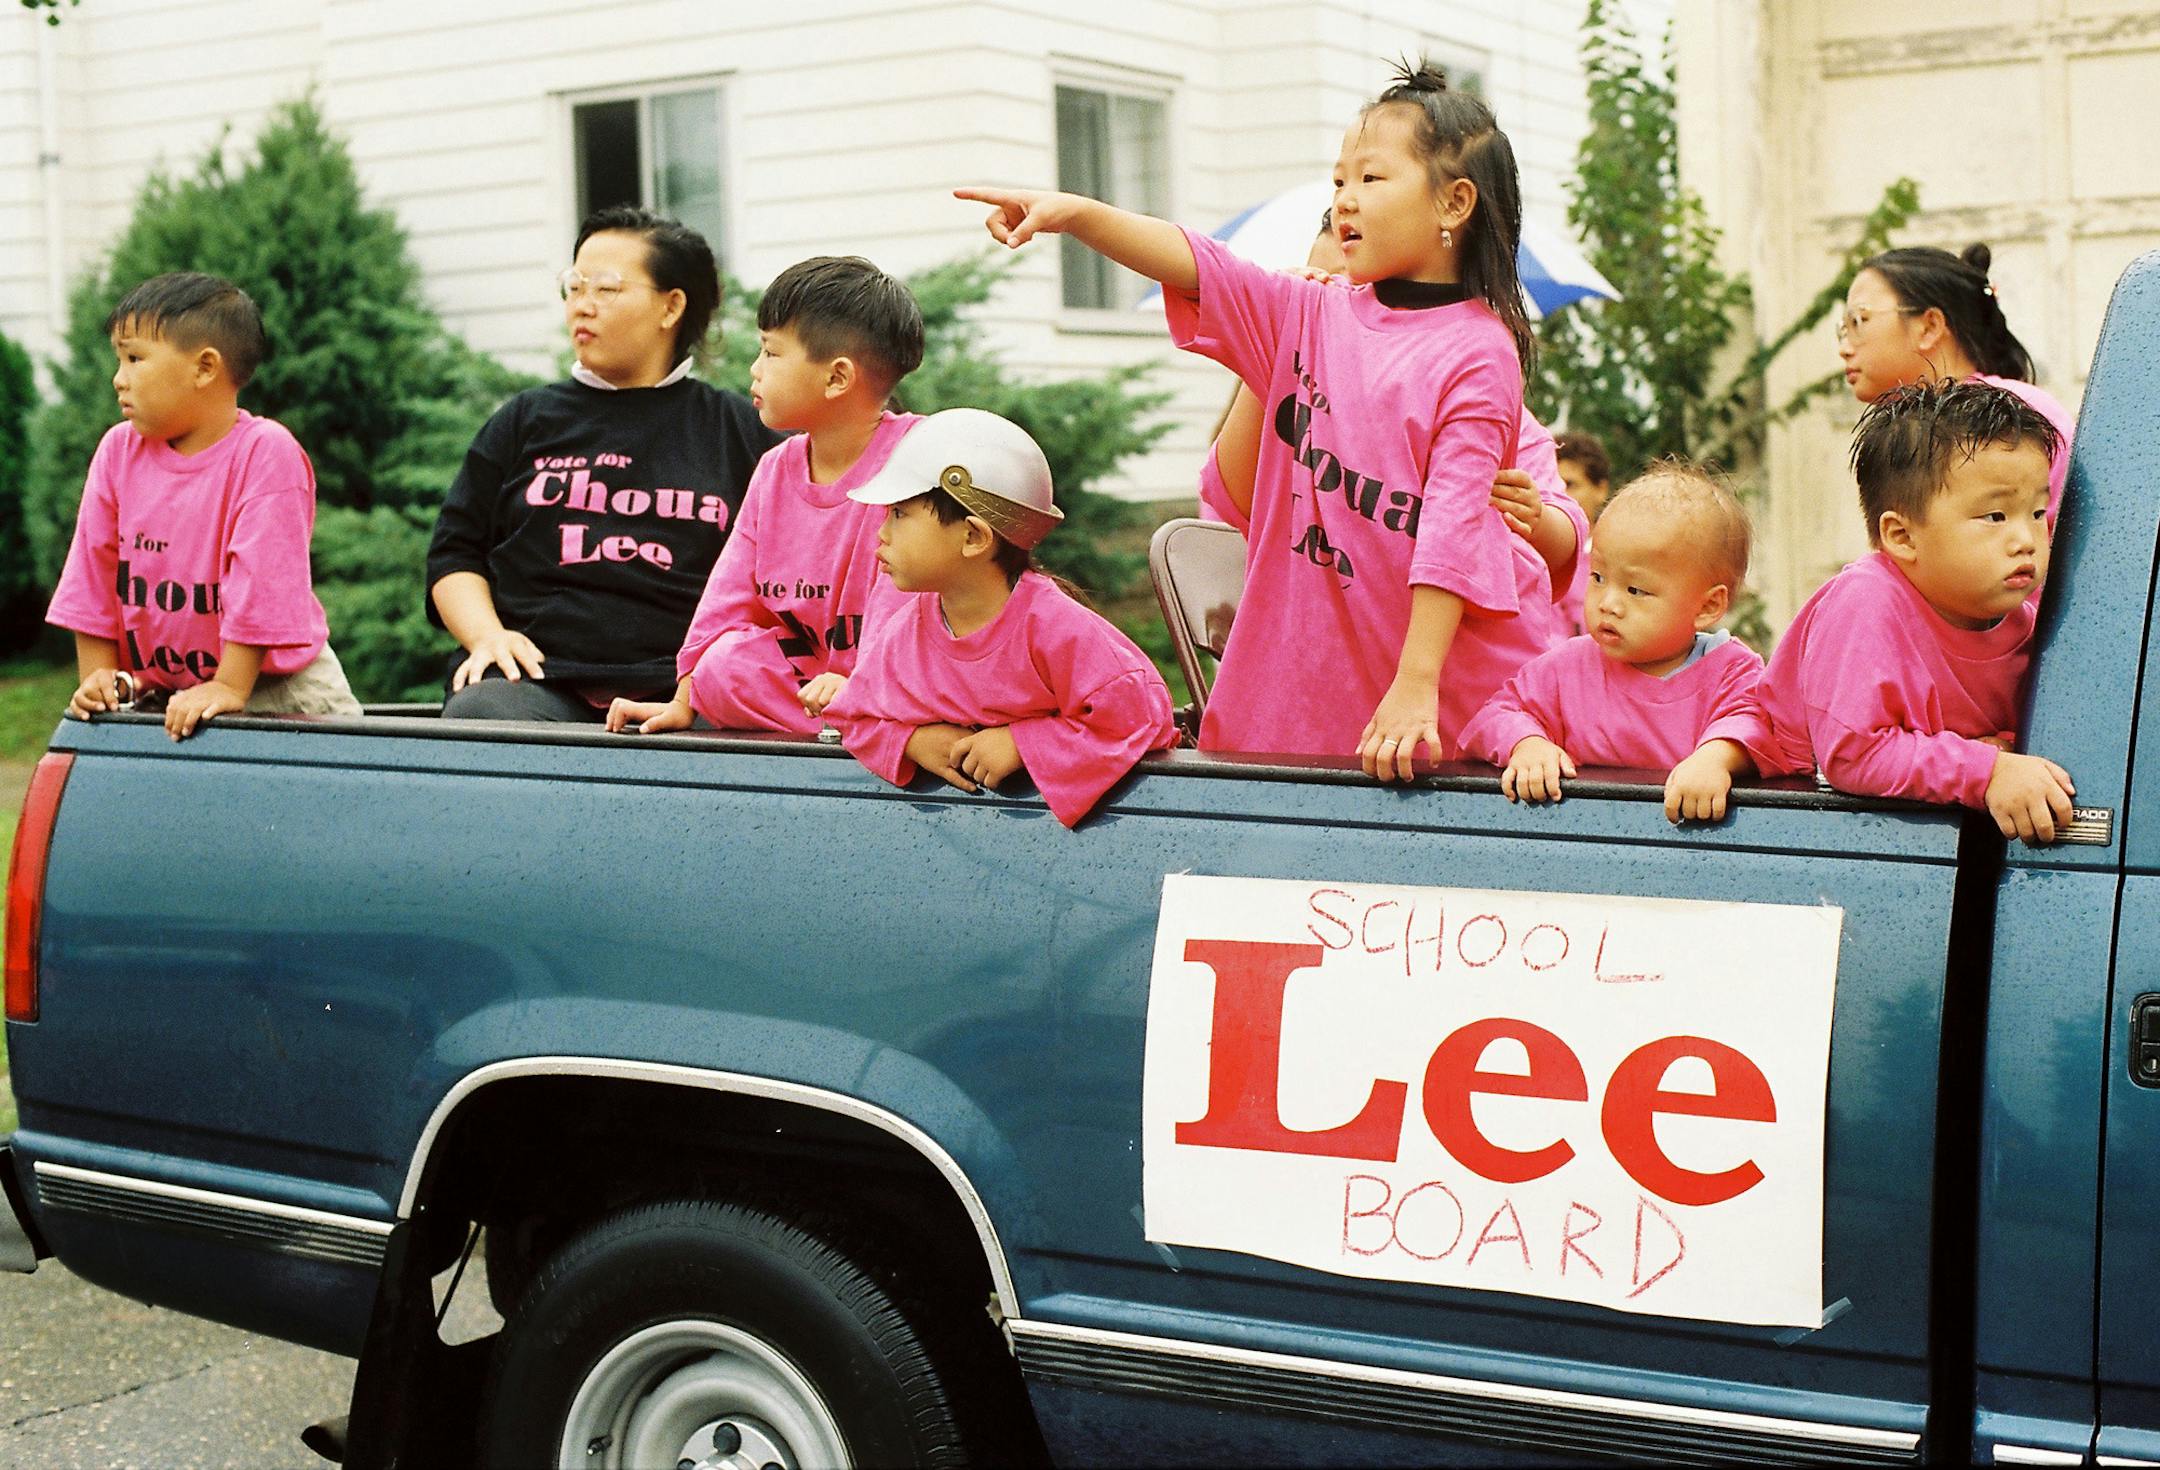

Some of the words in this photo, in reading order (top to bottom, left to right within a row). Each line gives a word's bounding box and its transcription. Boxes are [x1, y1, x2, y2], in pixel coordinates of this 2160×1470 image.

[533, 455, 588, 471] Vote
[594, 452, 633, 469] for
[525, 469, 730, 532] Choua
[133, 532, 169, 553] for
[558, 524, 674, 571] Lee
[116, 560, 224, 615] hou
[794, 578, 831, 599] for
[126, 629, 219, 682] Lee
[2072, 809, 2109, 820] RADO
[1307, 887, 1665, 985] SCHOOL
[1174, 938, 1778, 1207] Lee
[1342, 1173, 1686, 1300] BOARD
